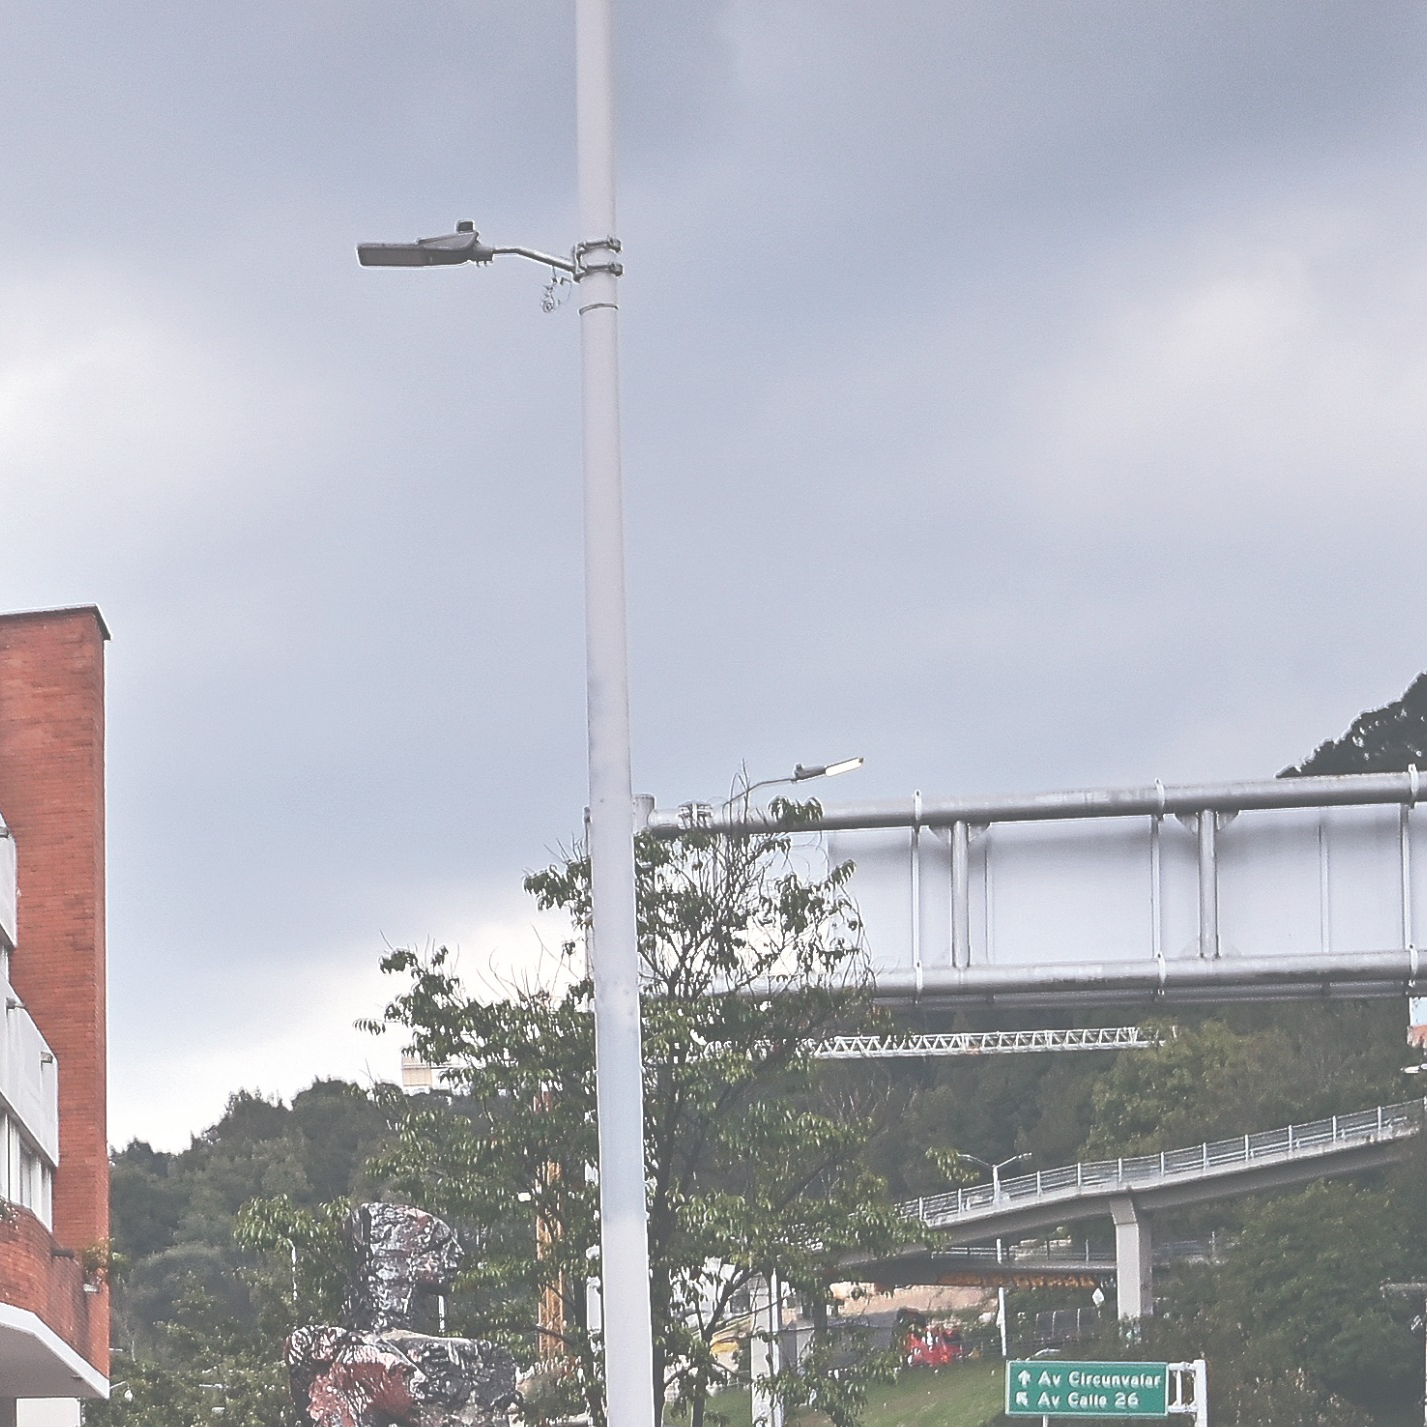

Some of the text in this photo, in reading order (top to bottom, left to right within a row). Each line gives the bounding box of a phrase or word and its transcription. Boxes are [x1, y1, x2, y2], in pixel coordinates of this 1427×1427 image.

[1037, 1371, 1162, 1388] Av Circunvalar
[1037, 1392, 1139, 1409] Av Calle 26
